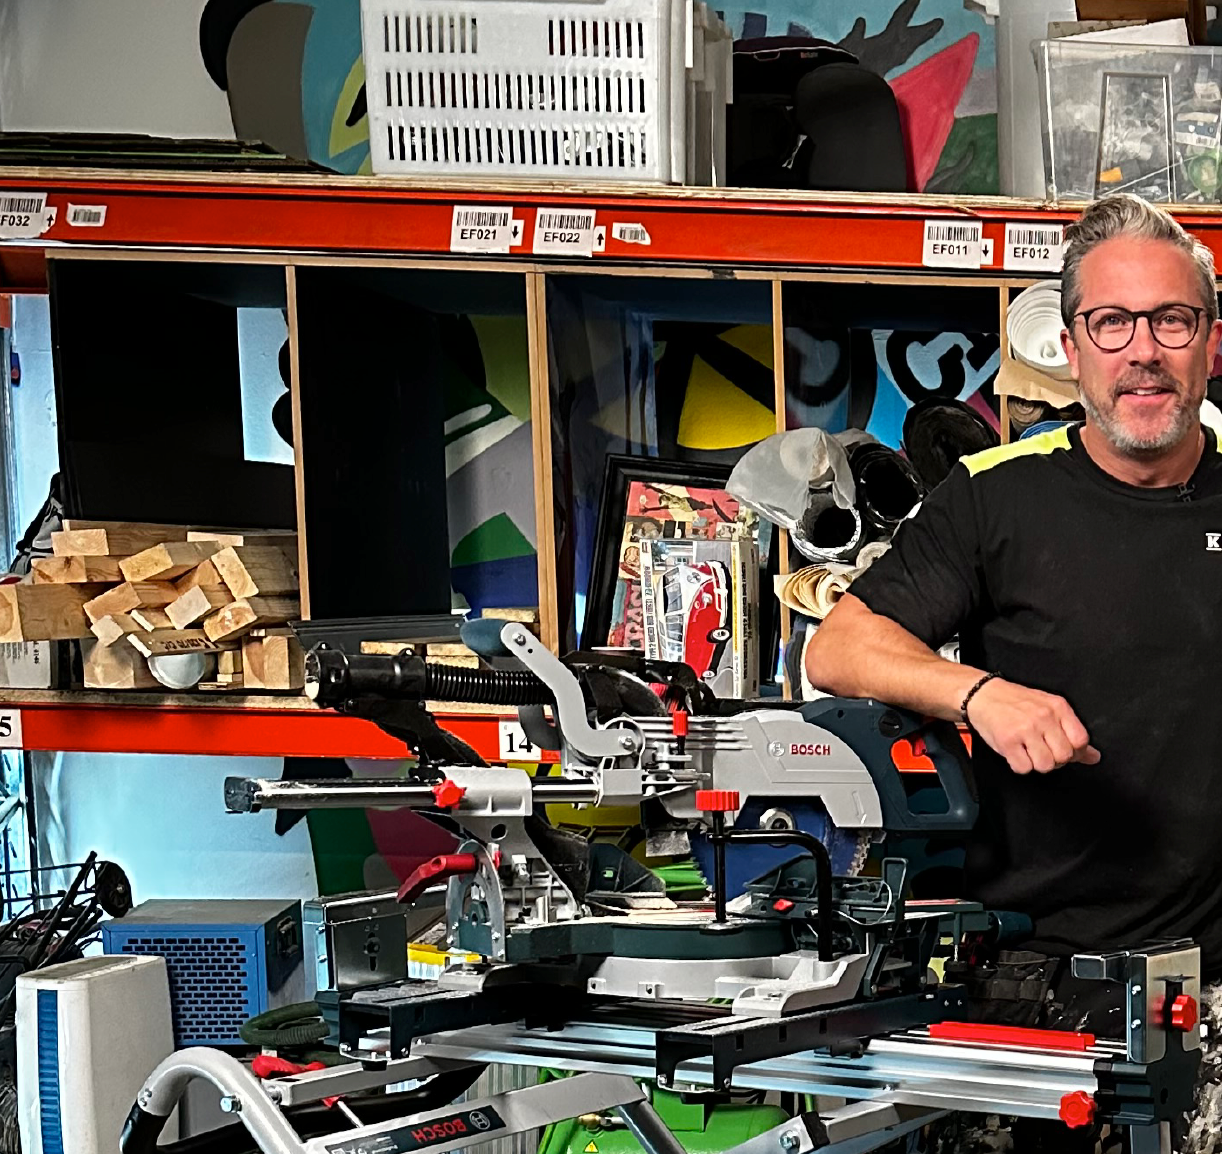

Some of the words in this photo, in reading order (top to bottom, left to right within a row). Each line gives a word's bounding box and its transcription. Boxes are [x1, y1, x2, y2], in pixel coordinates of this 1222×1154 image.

[0, 214, 30, 226] F032
[460, 228, 497, 241] EF021
[543, 231, 580, 243] EF022
[932, 243, 968, 255] EF011
[1013, 246, 1050, 259] EF012
[505, 732, 533, 753] 14
[790, 744, 831, 756] BOSCH
[411, 1118, 467, 1144] BOSCH
